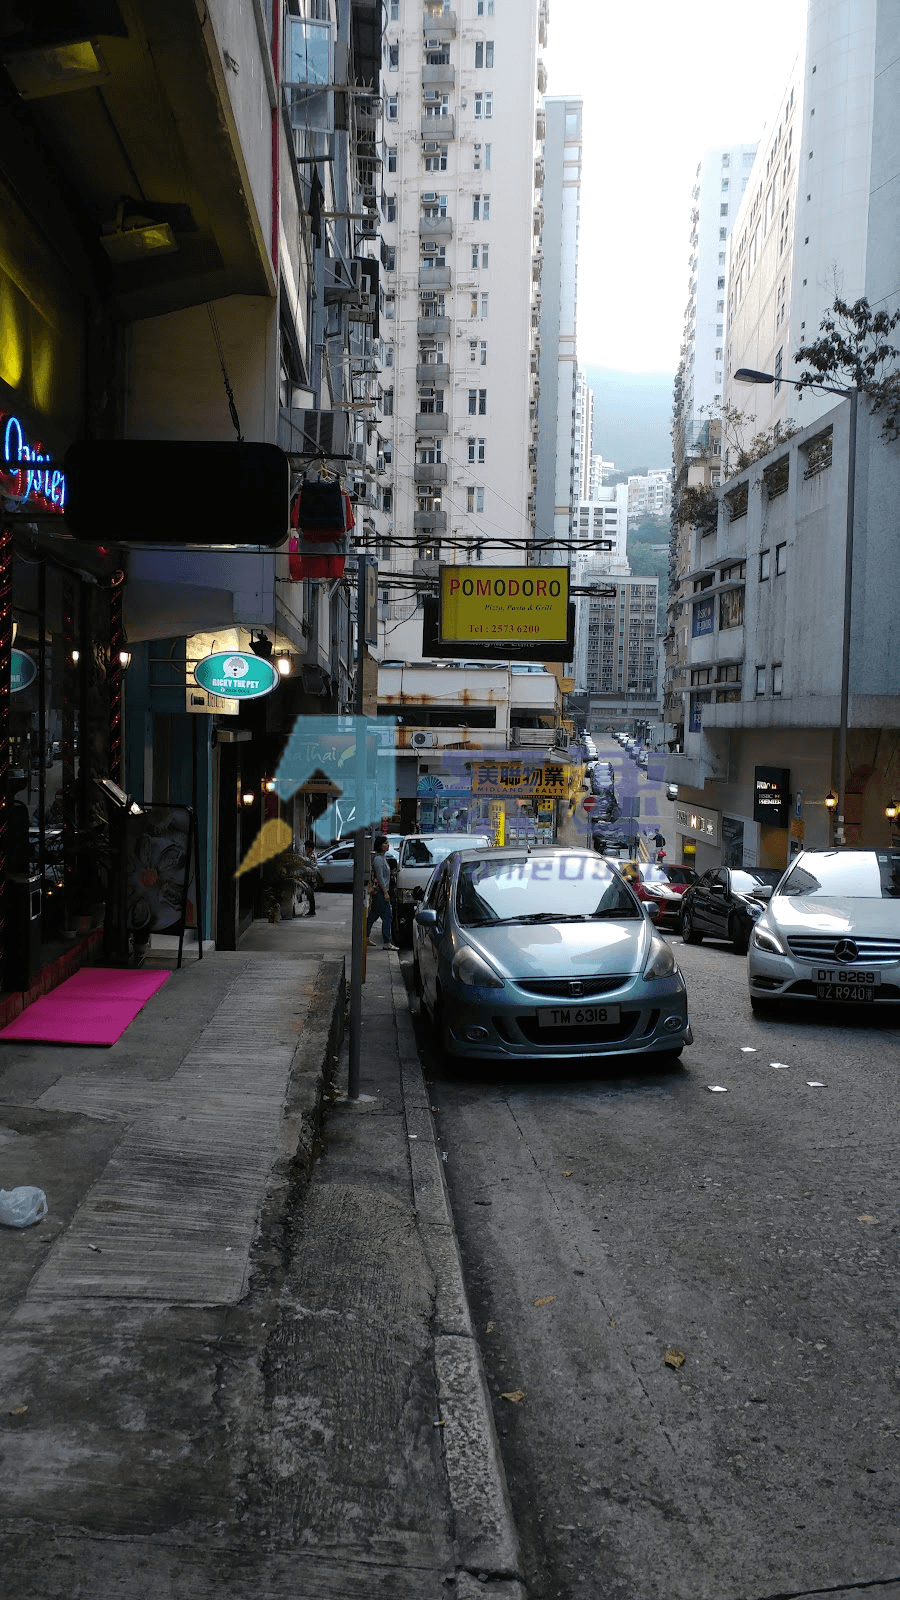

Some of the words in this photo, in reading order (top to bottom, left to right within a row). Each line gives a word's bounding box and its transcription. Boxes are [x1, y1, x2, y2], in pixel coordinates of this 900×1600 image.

[449, 579, 561, 597] POMODORO
[468, 624, 483, 633] Tel
[491, 624, 514, 633] 2573
[516, 624, 540, 633] 6200
[212, 679, 232, 687] RICKY
[233, 680, 246, 688] THE
[246, 681, 259, 689] PET
[303, 742, 337, 763] Thai
[477, 765, 565, 787] 美聯物業
[817, 969, 836, 981] DT
[838, 971, 875, 984] 8269
[551, 1009, 571, 1024] TM
[574, 1008, 608, 1023] 6318
